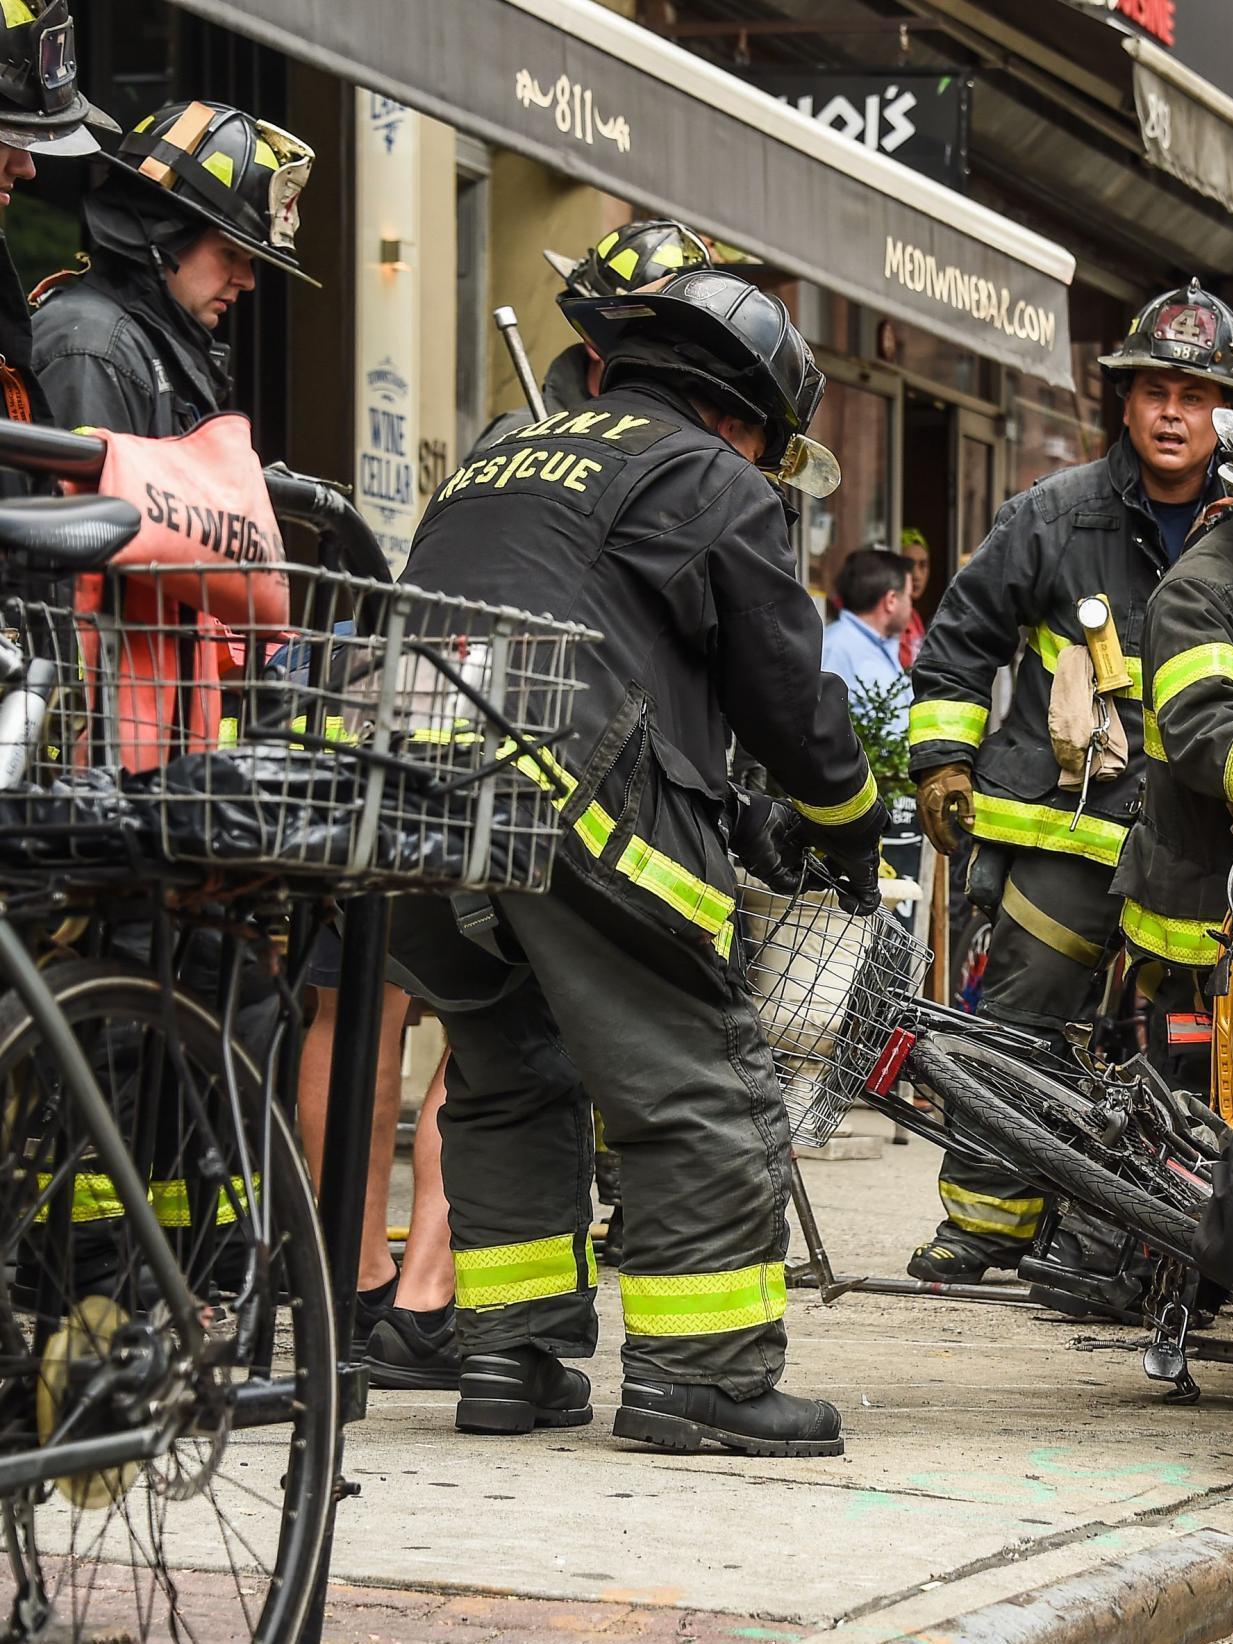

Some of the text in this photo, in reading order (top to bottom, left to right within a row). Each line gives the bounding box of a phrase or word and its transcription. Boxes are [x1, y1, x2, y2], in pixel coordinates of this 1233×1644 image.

[555, 73, 594, 145] 811
[884, 235, 1056, 351] MEDIWINEBAR.COM
[1171, 309, 1201, 342] 4
[368, 406, 407, 458] WINE
[361, 453, 415, 505] CELLAR
